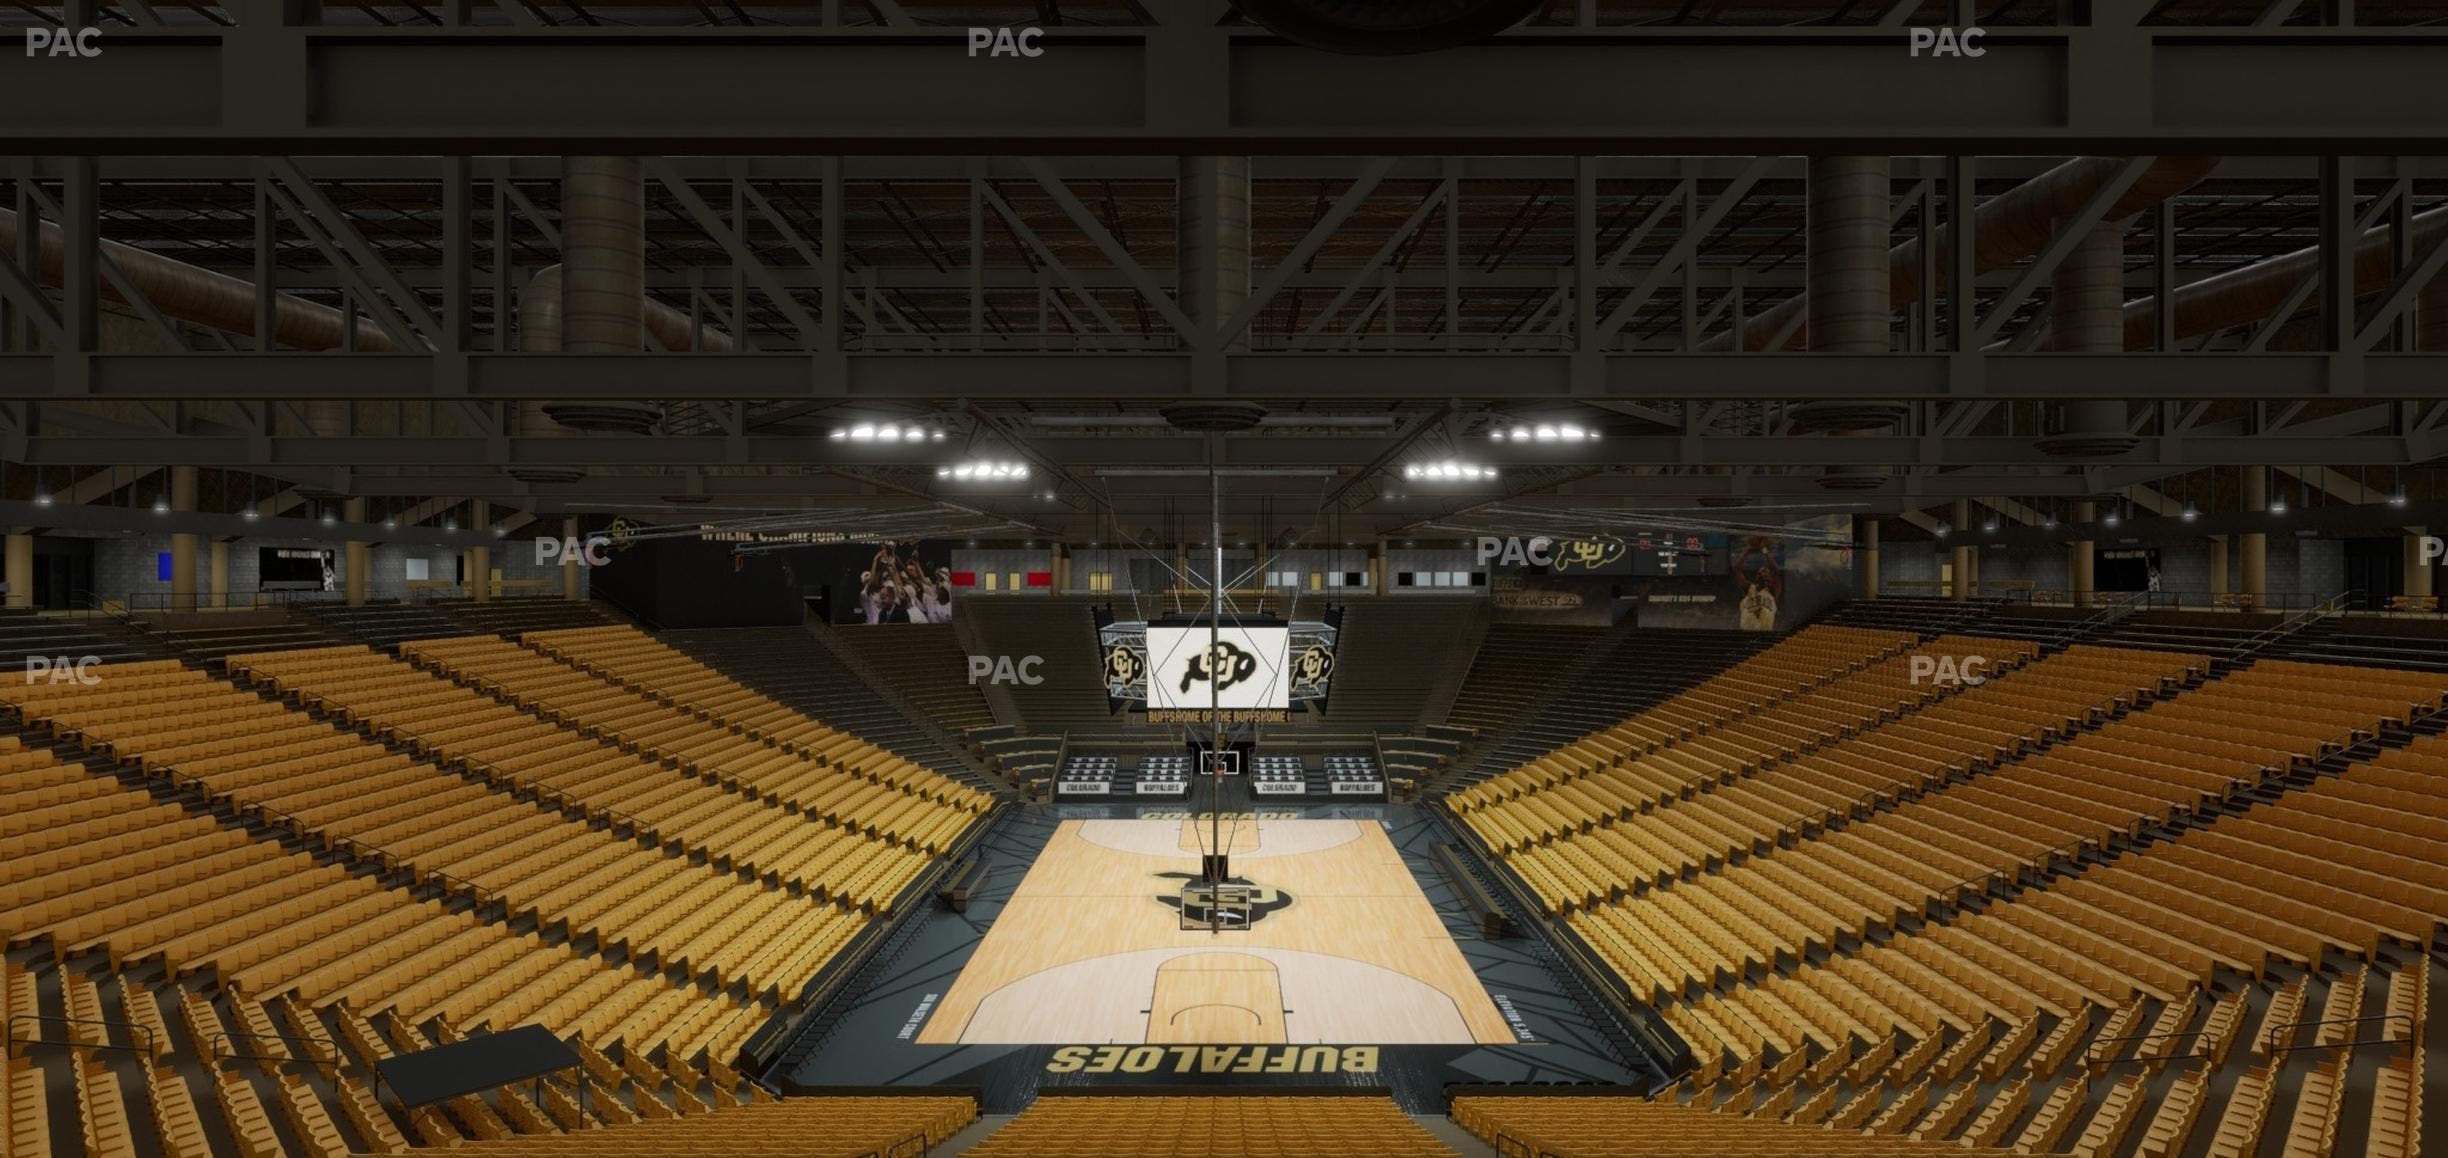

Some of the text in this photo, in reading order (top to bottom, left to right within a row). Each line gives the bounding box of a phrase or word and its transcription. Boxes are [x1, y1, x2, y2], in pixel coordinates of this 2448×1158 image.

[1527, 596, 1560, 606] WEST
[1202, 711, 1212, 722] OF
[1217, 711, 1231, 722] THE
[1066, 783, 1101, 792] COLORADO
[1261, 783, 1297, 792] COLORADO
[1046, 1046, 1379, 1073] BUFFALOES
